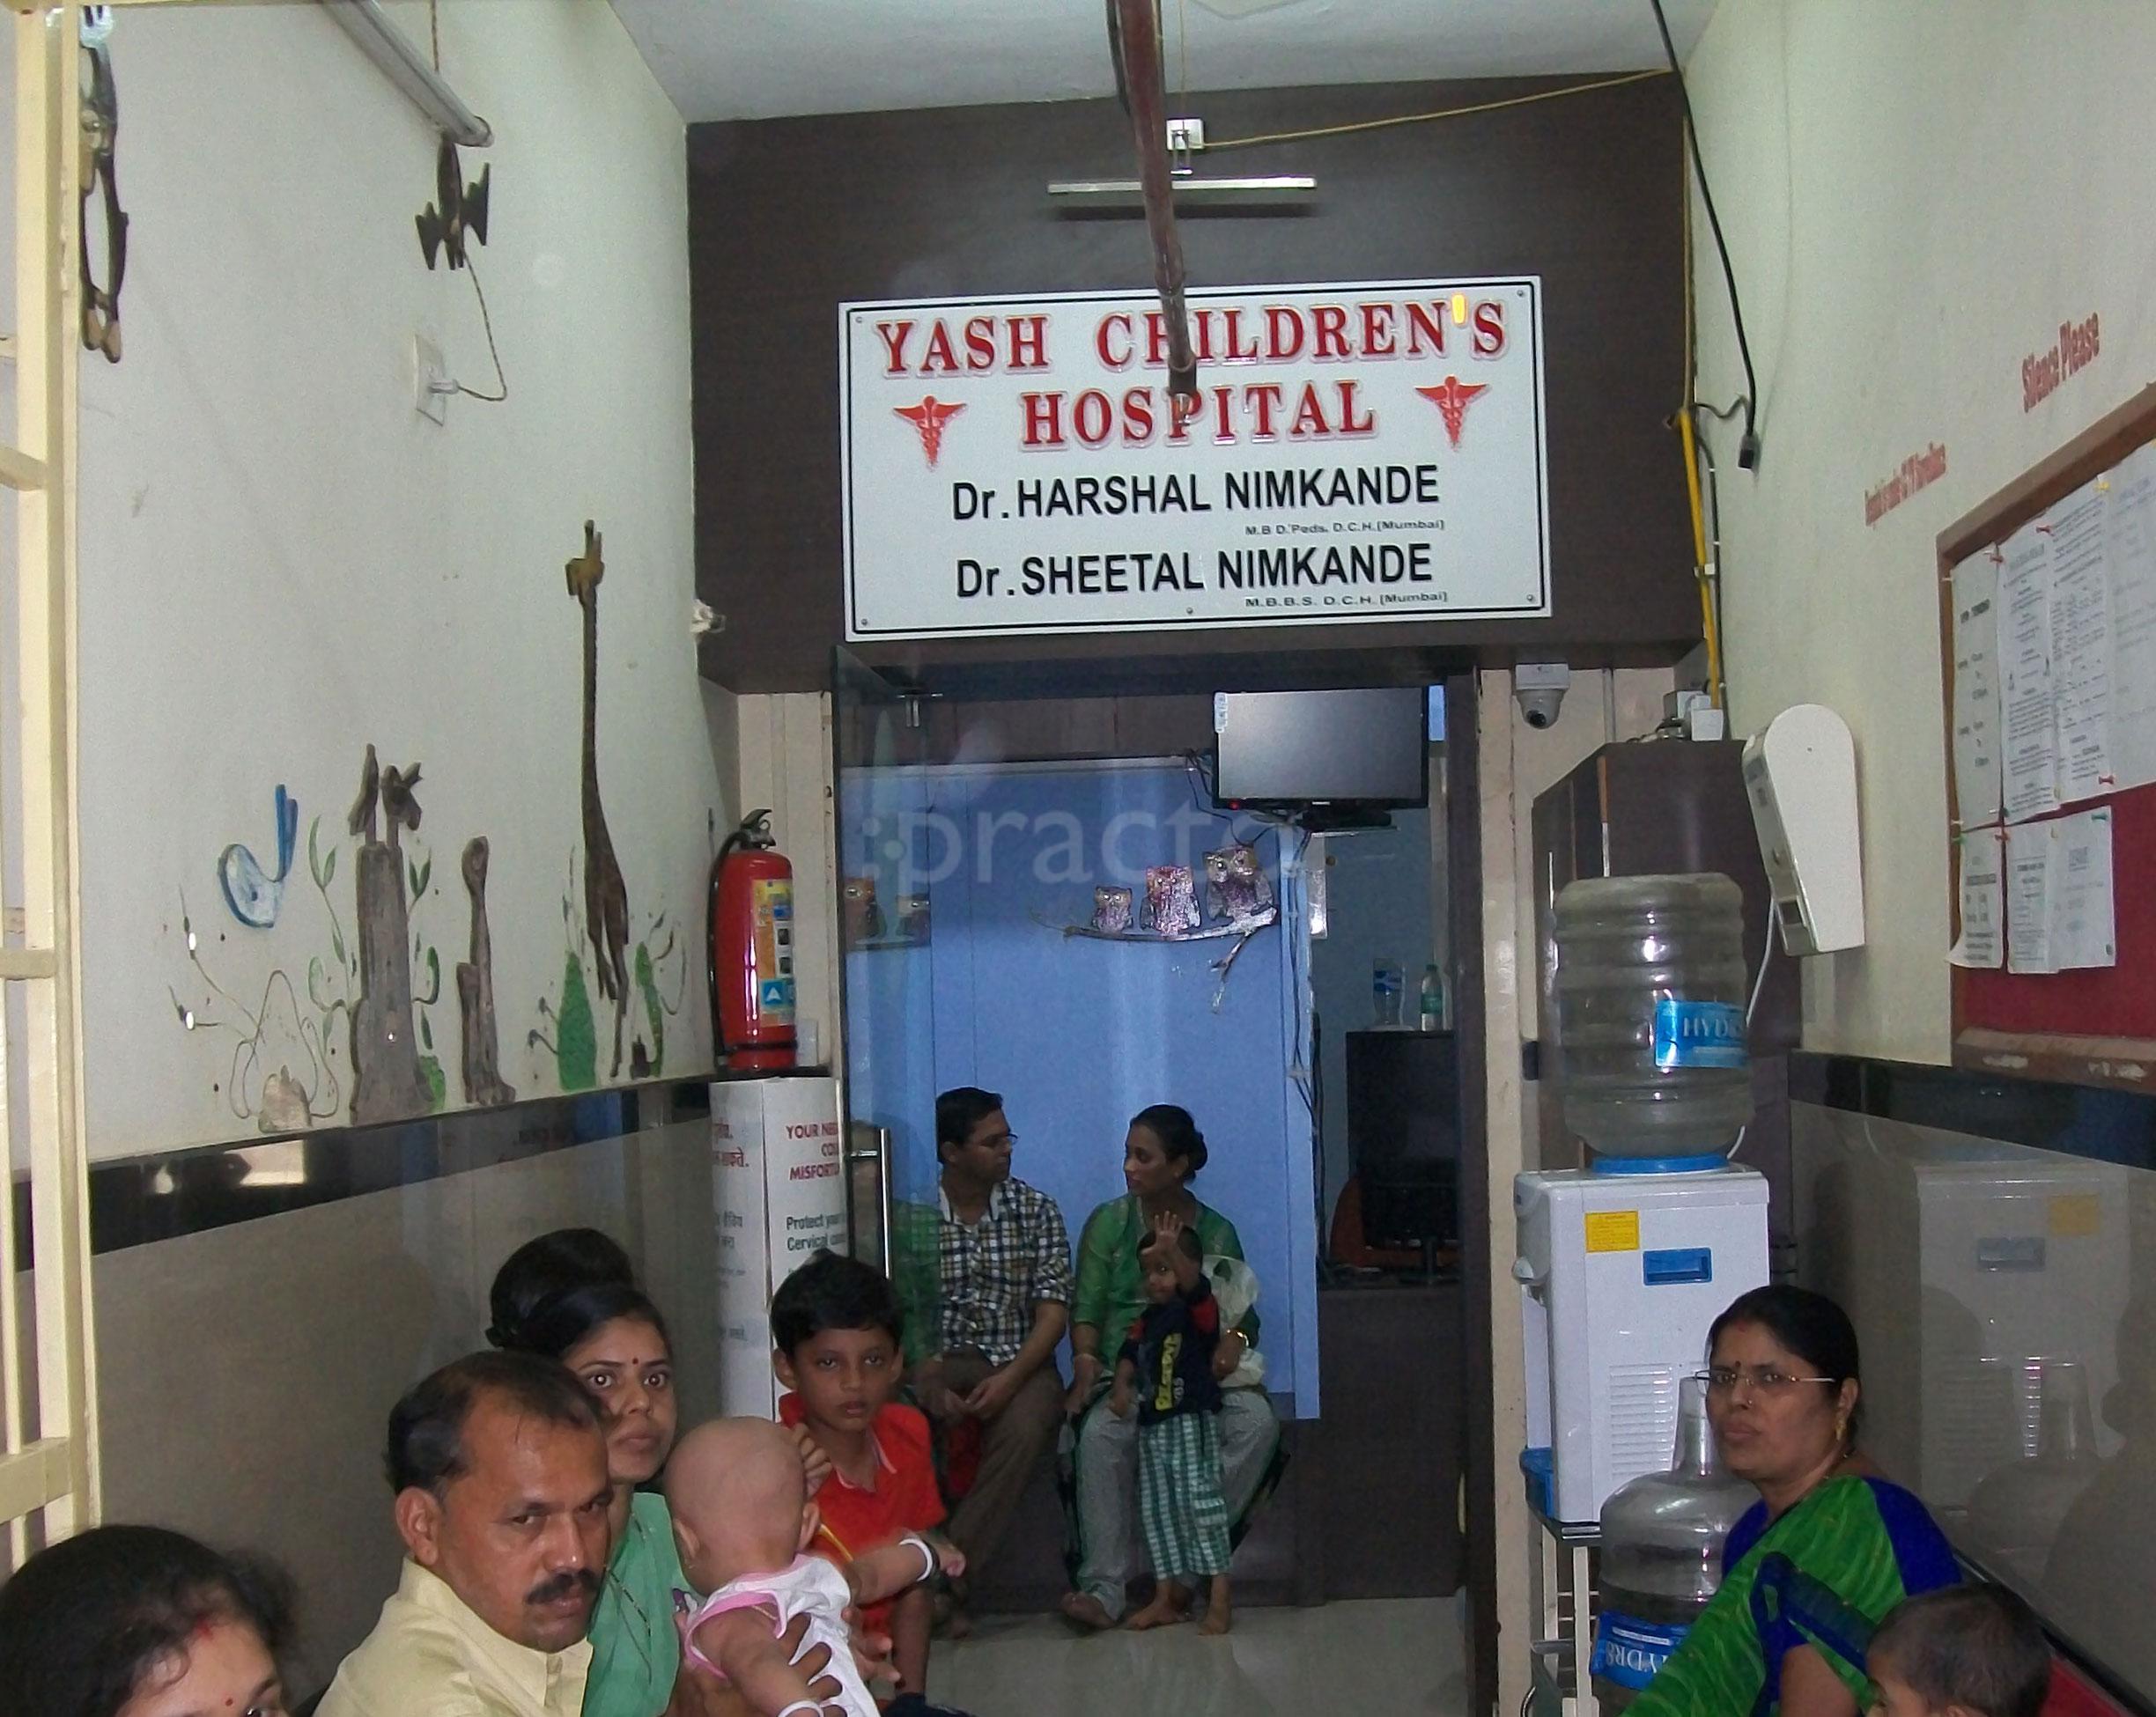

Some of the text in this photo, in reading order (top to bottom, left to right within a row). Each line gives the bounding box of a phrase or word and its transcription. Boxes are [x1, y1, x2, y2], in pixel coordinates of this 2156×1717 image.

[876, 314, 1051, 377] YASH
[2059, 312, 2100, 381] Please
[1021, 379, 1376, 448] HOSPITAL
[1225, 464, 1440, 510] NIMKANDE
[1218, 542, 1433, 589] NIMKANDE
[786, 1124, 818, 1139] YOUR
[786, 1214, 823, 1231] Protect
[787, 1235, 828, 1251] Cervical
